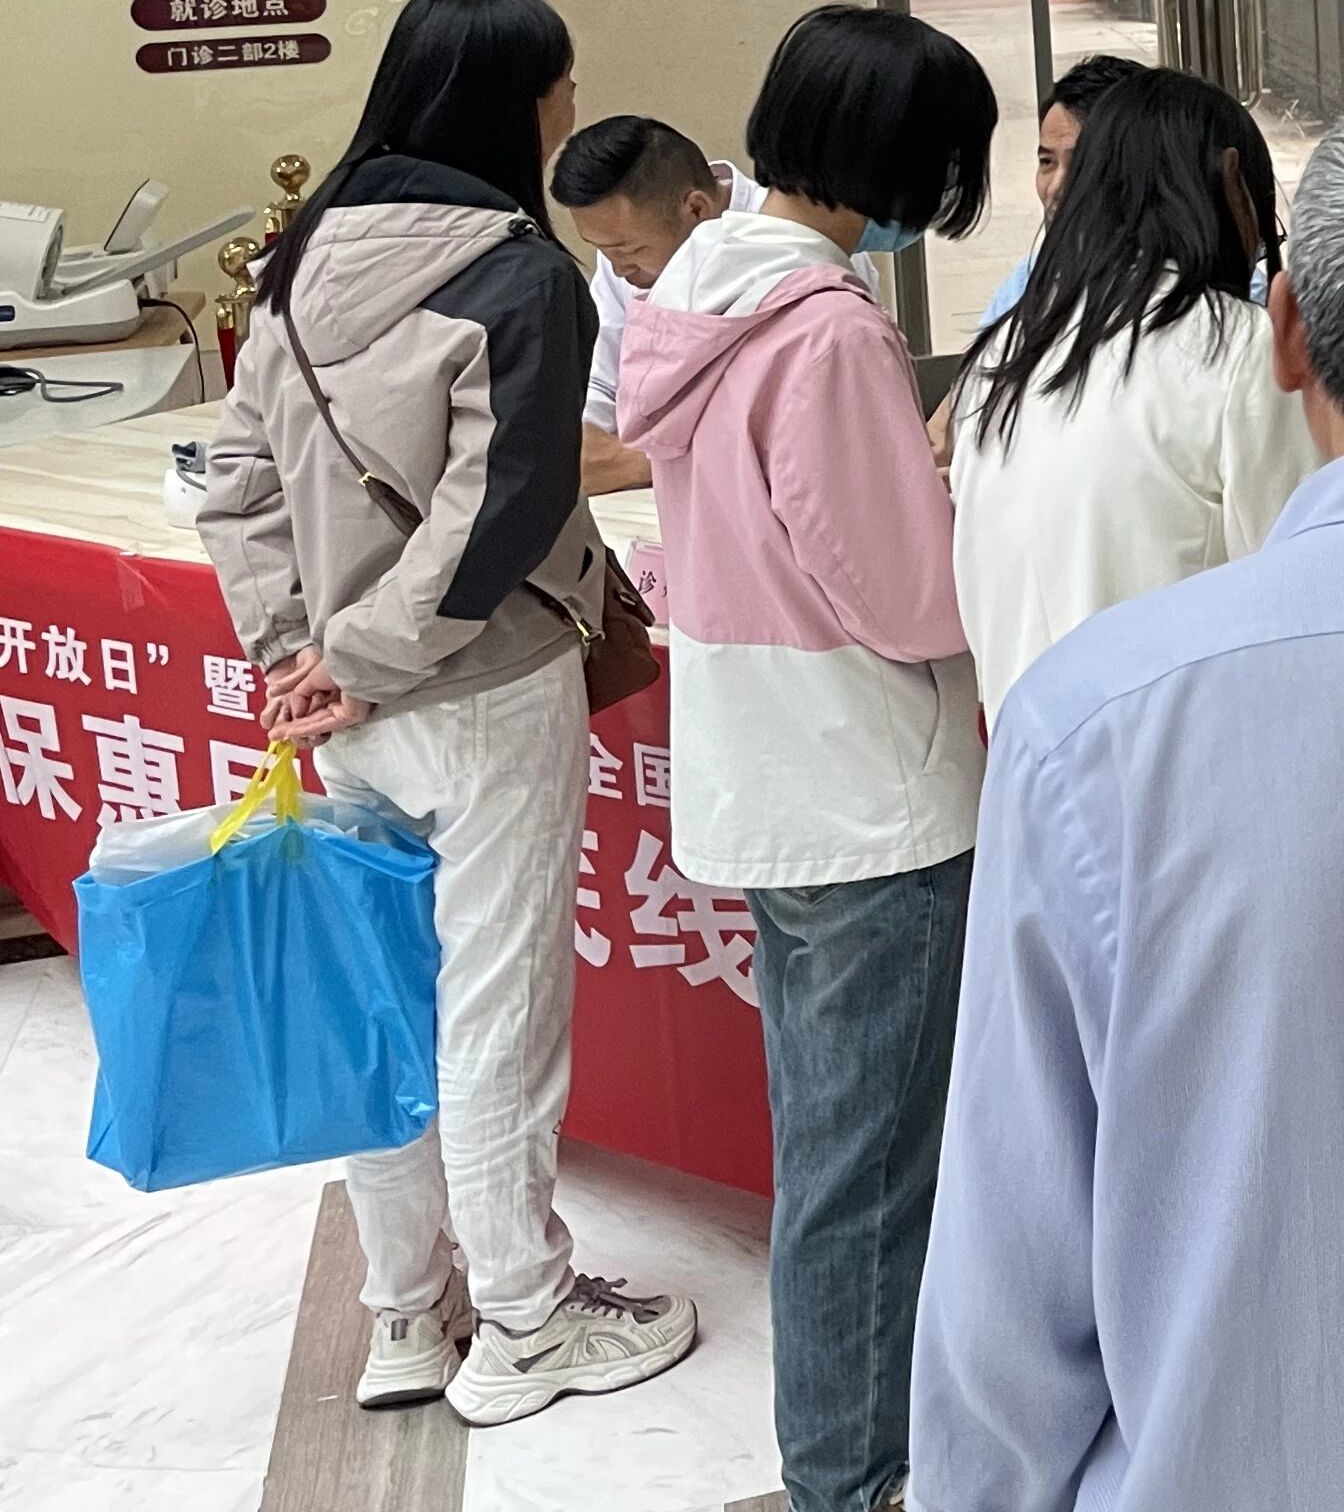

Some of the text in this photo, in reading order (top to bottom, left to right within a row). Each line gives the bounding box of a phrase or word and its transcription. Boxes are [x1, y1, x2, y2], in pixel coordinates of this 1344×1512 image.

[167, 39, 300, 67] 门诊二部2楼
[203, 654, 257, 720] 暨
